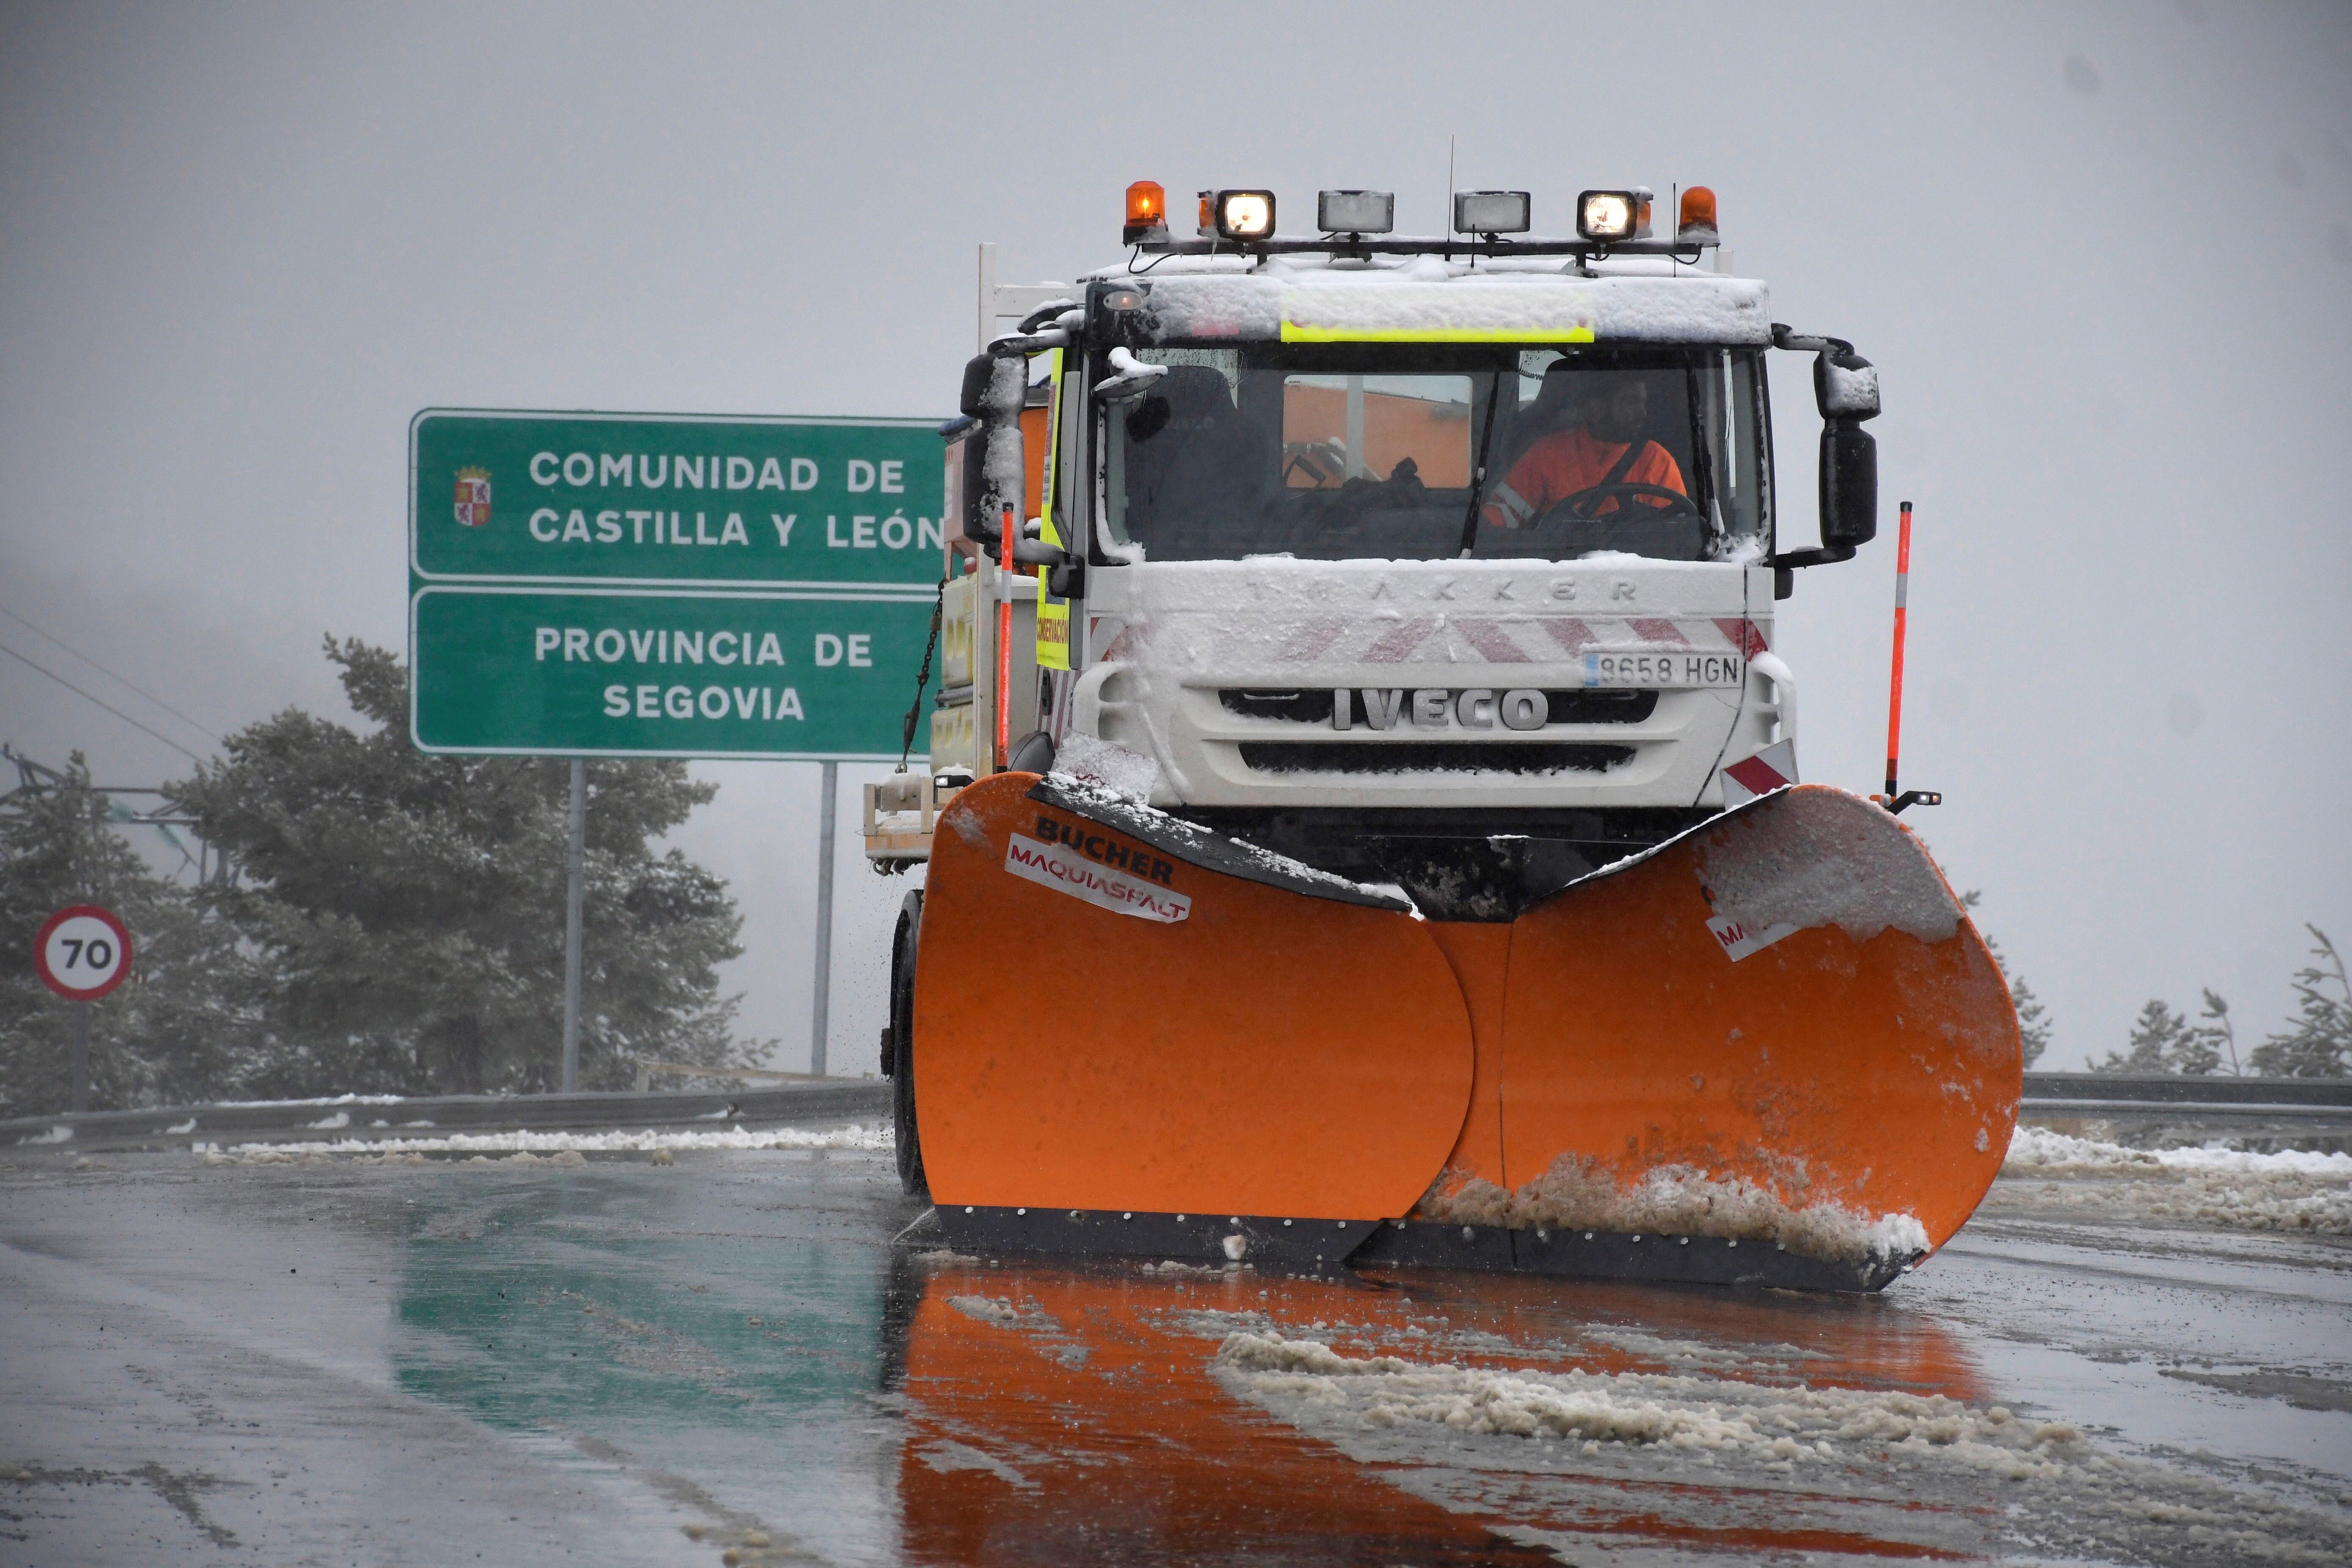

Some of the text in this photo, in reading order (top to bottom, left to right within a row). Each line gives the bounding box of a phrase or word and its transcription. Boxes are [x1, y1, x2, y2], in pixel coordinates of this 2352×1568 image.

[529, 452, 905, 493] COMUNIDAD DE
[529, 508, 945, 550] CASTILLA Y LEÓN
[535, 627, 873, 667] PROVINCIA DE
[1037, 613, 1068, 644] CONSERVACIÓN
[1686, 658, 1737, 683] HGN
[603, 685, 805, 721] SEGOVIA
[1334, 689, 1549, 730] IVECO
[1036, 816, 1173, 885] BUCHER
[1010, 844, 1186, 919] MAQUIASFALT
[61, 939, 112, 969] 70
